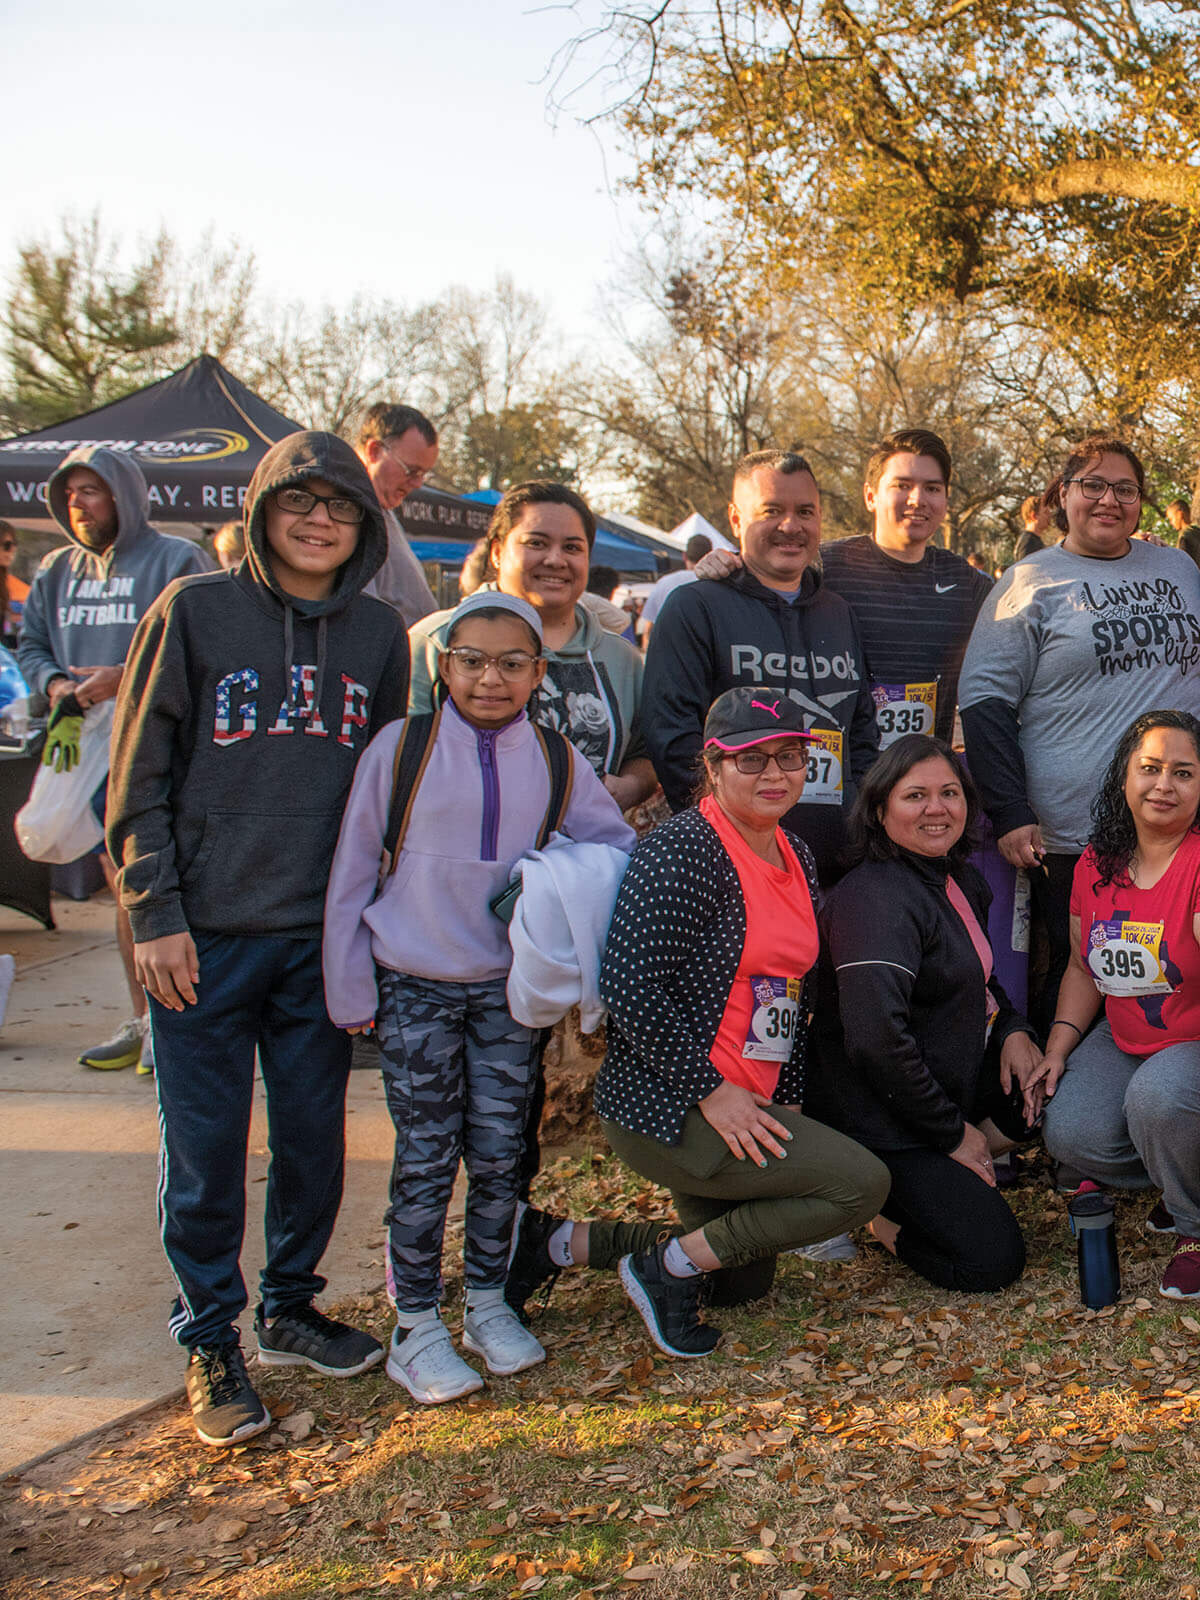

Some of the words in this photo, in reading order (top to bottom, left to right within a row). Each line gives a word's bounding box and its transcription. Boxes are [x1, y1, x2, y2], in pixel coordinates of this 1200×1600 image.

[2, 440, 137, 451] STRETCH
[134, 441, 213, 454] ZONE
[148, 483, 191, 507] AY.
[1083, 578, 1180, 610] Living
[1131, 603, 1160, 616] that
[731, 644, 860, 682] Reebok
[1100, 648, 1161, 676] mom
[1165, 637, 1200, 676] life
[213, 667, 370, 749] GAP
[880, 708, 925, 733] 335
[805, 756, 832, 784] 37
[1100, 948, 1146, 979] 395
